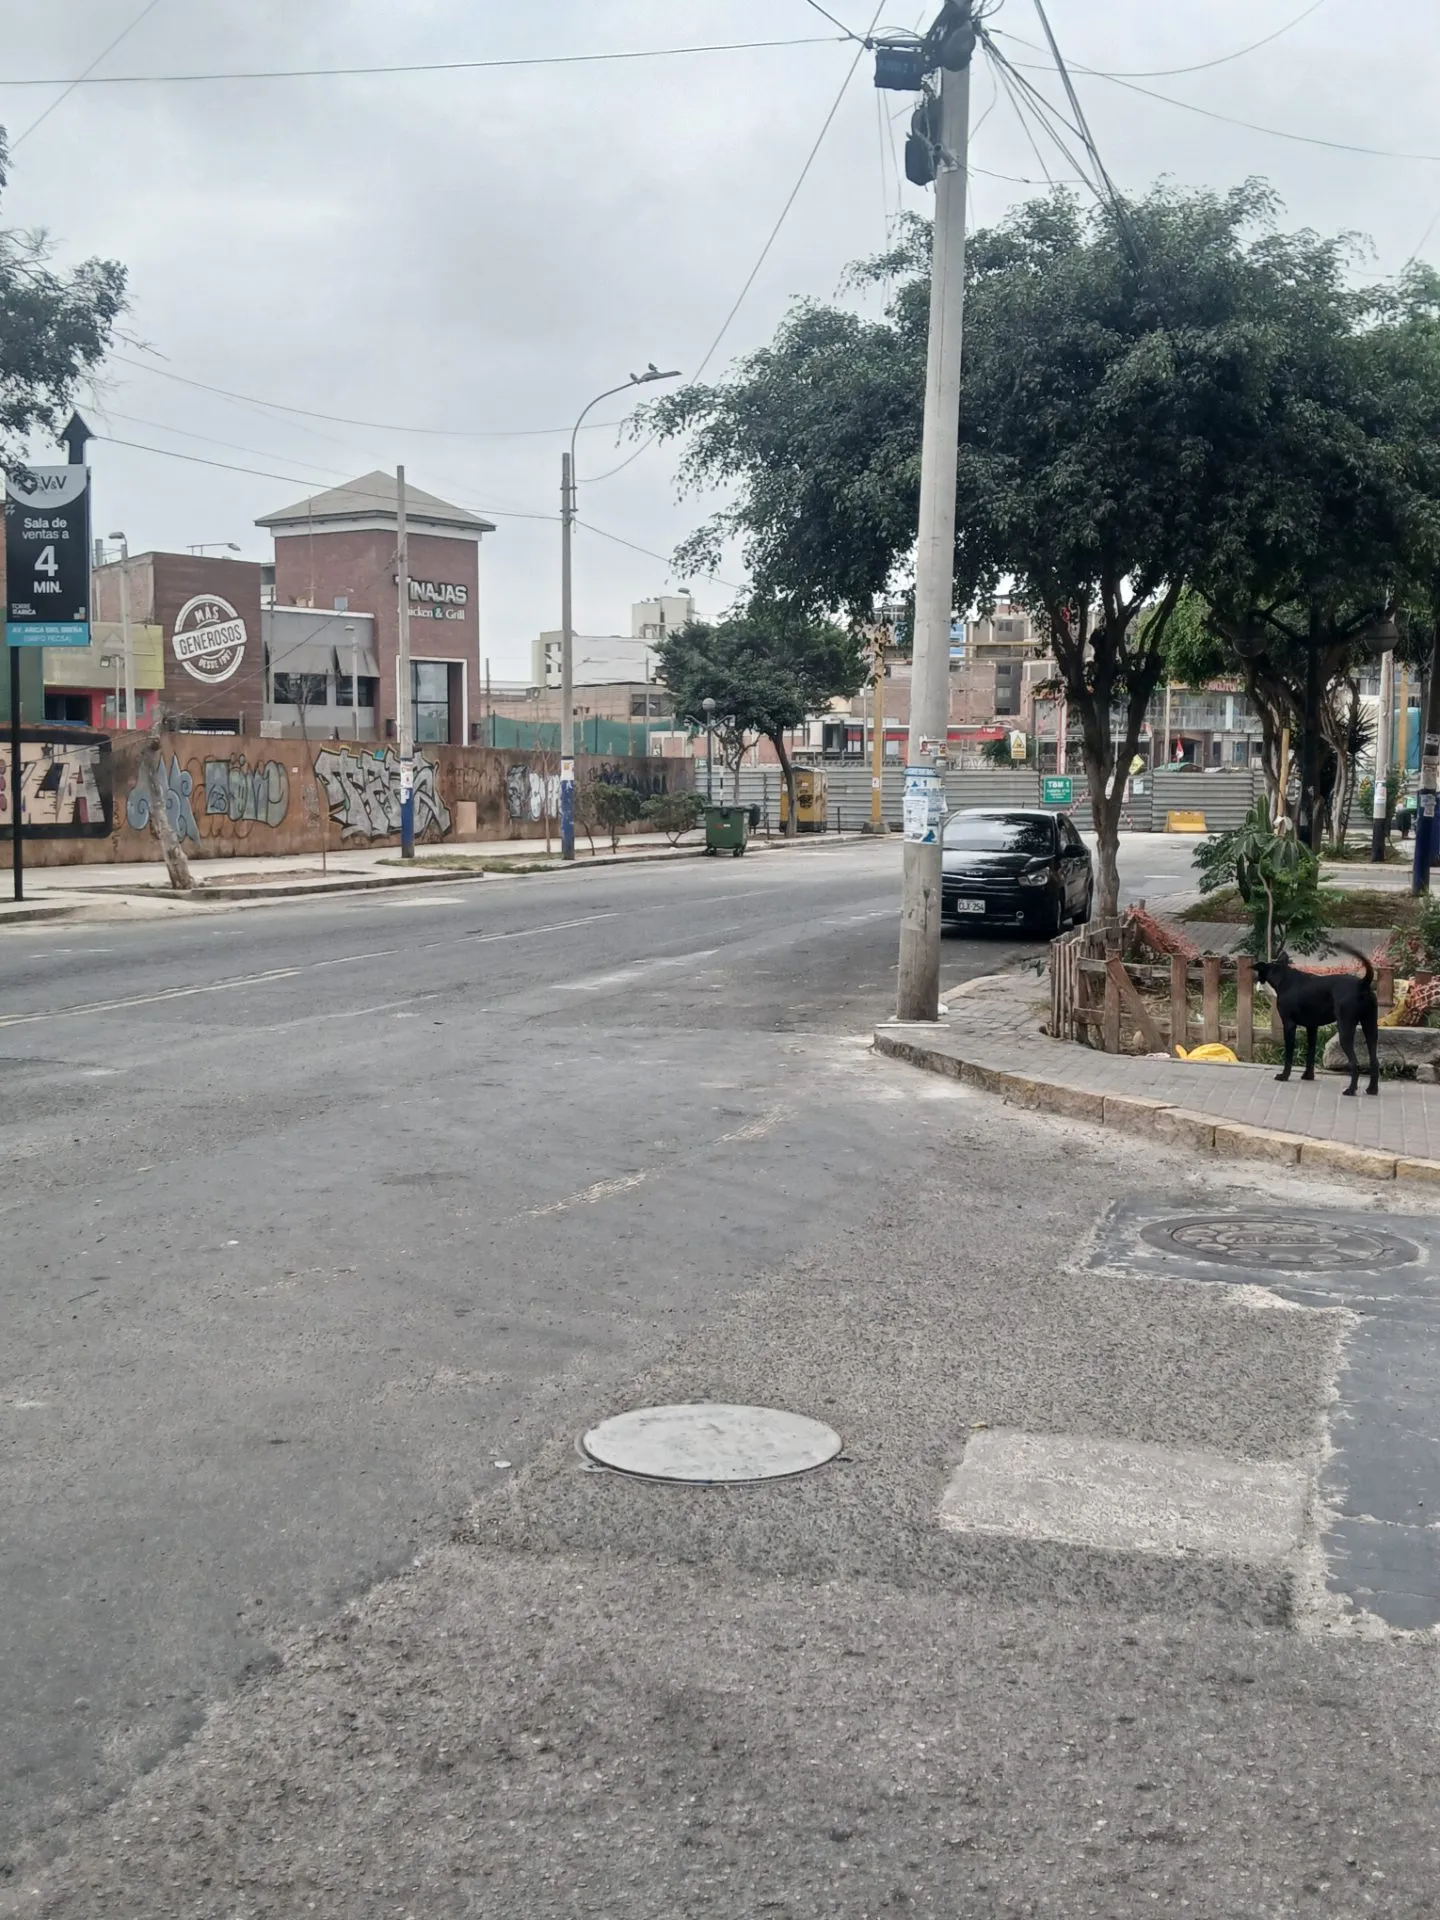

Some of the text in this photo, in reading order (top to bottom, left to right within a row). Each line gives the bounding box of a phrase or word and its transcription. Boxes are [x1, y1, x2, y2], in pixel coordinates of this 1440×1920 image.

[23, 517, 67, 528] Sala de
[22, 529, 69, 539] ventas a
[34, 545, 59, 577] 4
[33, 580, 62, 593] MIN.
[194, 603, 220, 624] MÁS
[434, 606, 443, 619] &
[445, 609, 465, 620] Grill
[179, 624, 242, 655] GENEROSOS
